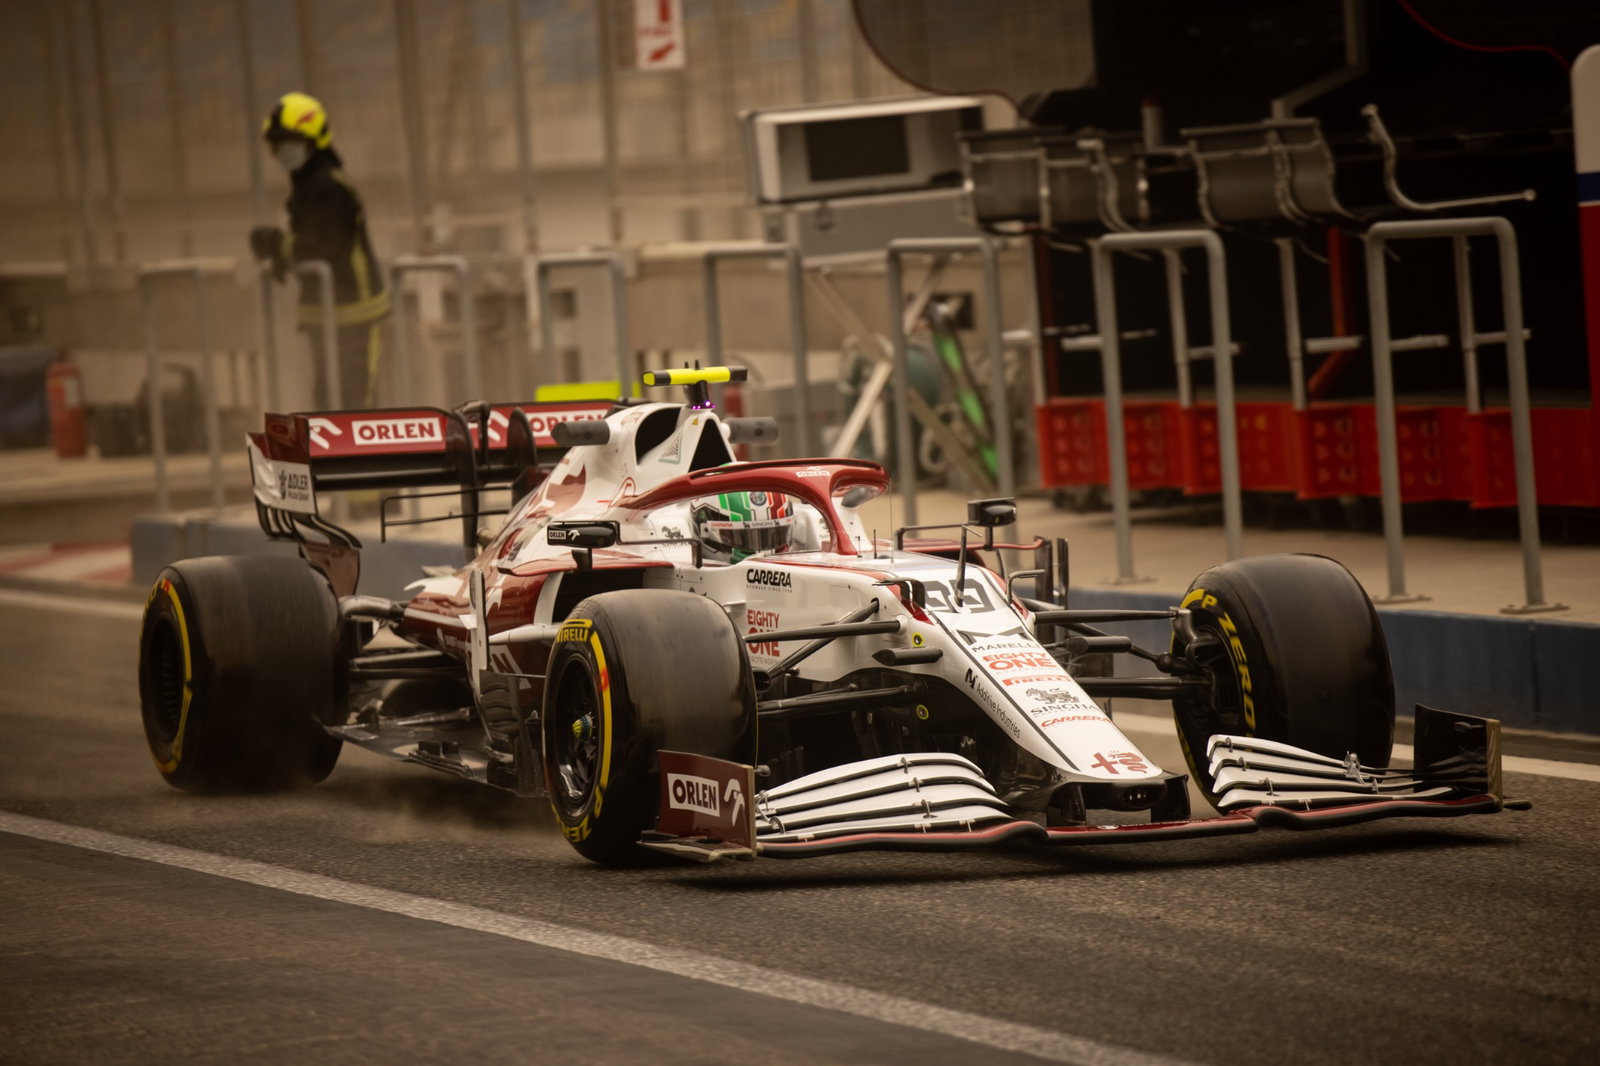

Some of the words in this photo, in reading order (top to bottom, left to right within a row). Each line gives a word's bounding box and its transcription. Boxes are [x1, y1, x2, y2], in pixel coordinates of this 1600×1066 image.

[358, 421, 435, 441] ORLEN
[549, 531, 565, 539] ORLEN
[746, 568, 792, 588] CARRERA
[747, 609, 780, 629] EIGHTY
[556, 618, 592, 643] PIRELLI
[748, 626, 780, 657] ONE
[971, 642, 1040, 652] MARELLI
[982, 652, 1047, 662] EIGHTY
[988, 658, 1057, 671] ONE
[1200, 594, 1218, 609] P
[1217, 611, 1256, 731] ZERO
[1030, 703, 1101, 713] SINGHA
[996, 703, 1021, 739] Industries
[1041, 715, 1111, 727] CARRERA
[672, 778, 718, 811] ORLEN
